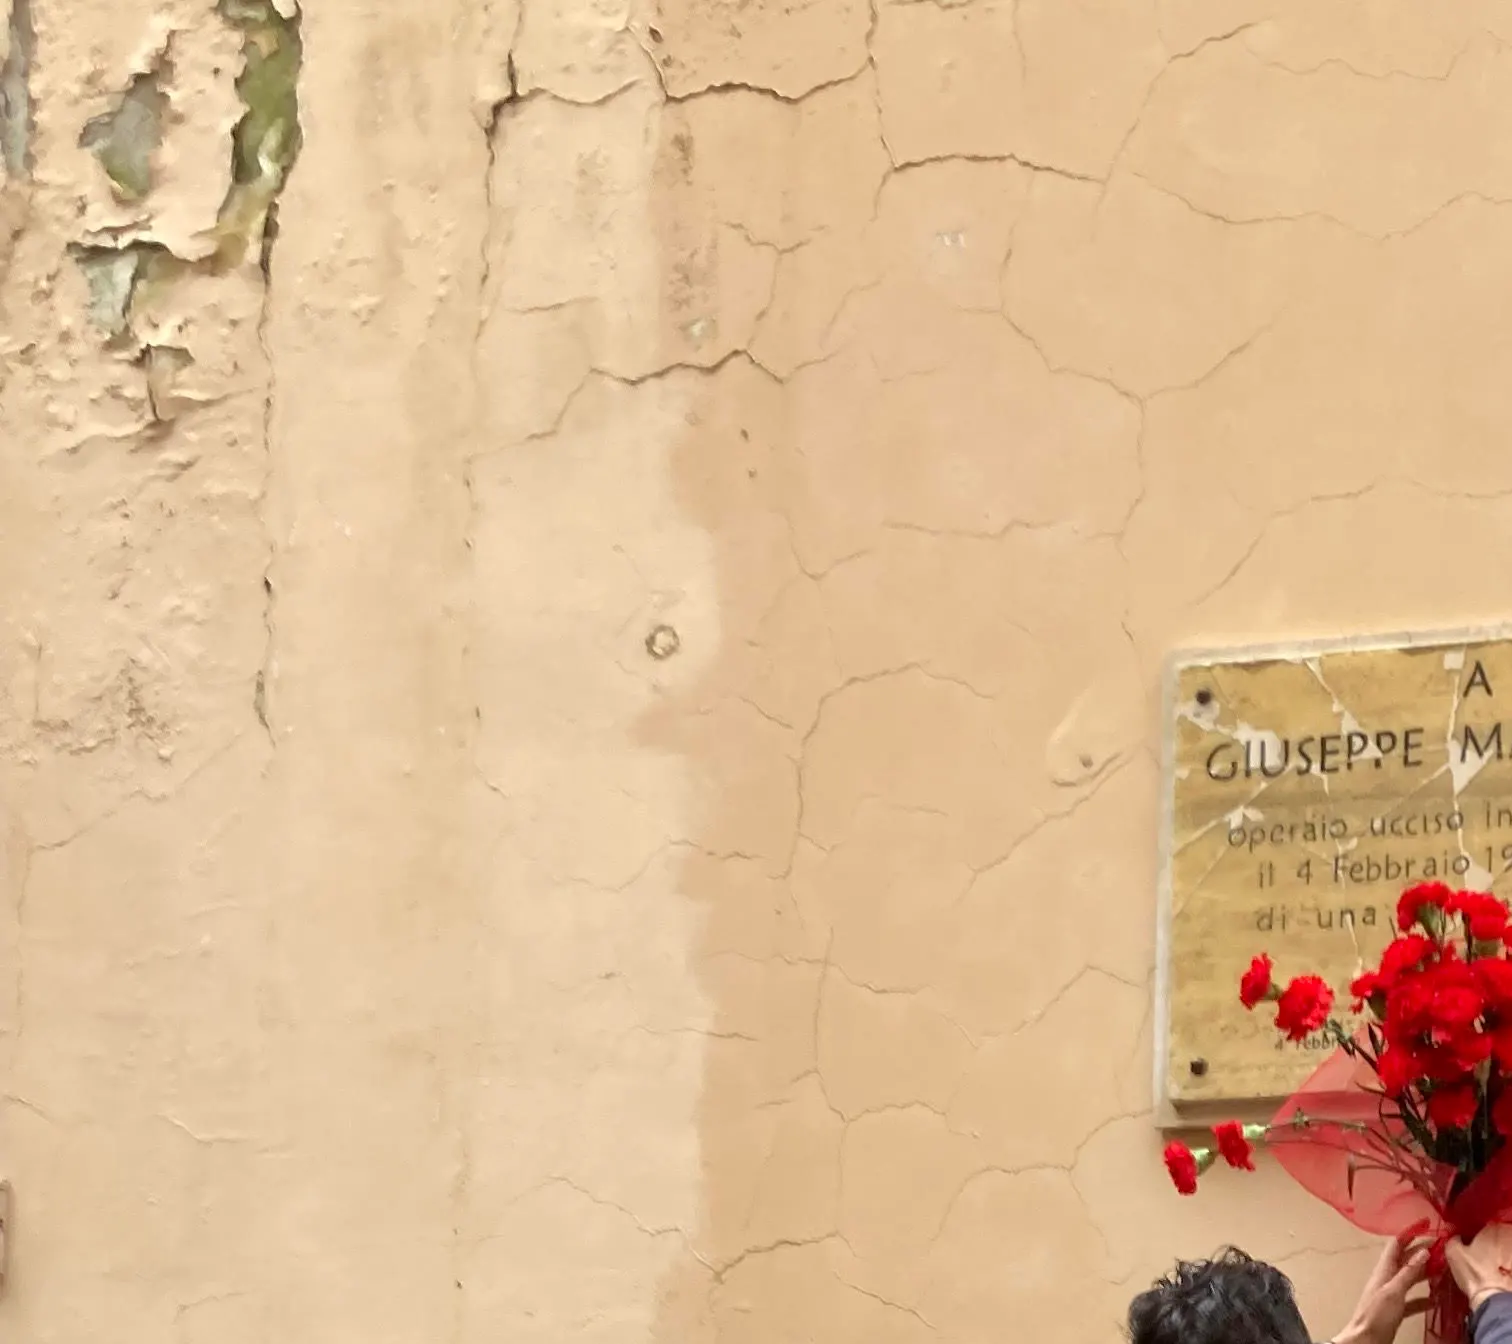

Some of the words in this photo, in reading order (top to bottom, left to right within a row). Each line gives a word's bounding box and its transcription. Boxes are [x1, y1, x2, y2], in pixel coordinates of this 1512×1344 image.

[1463, 661, 1493, 698] A
[1206, 727, 1425, 781] GIUSEPPE
[1227, 811, 1348, 853] operaio
[1369, 810, 1465, 838] ucciso
[1296, 858, 1313, 886] 4
[1332, 850, 1471, 884] Febbraio
[1256, 904, 1287, 932] di
[1316, 905, 1377, 929] una
